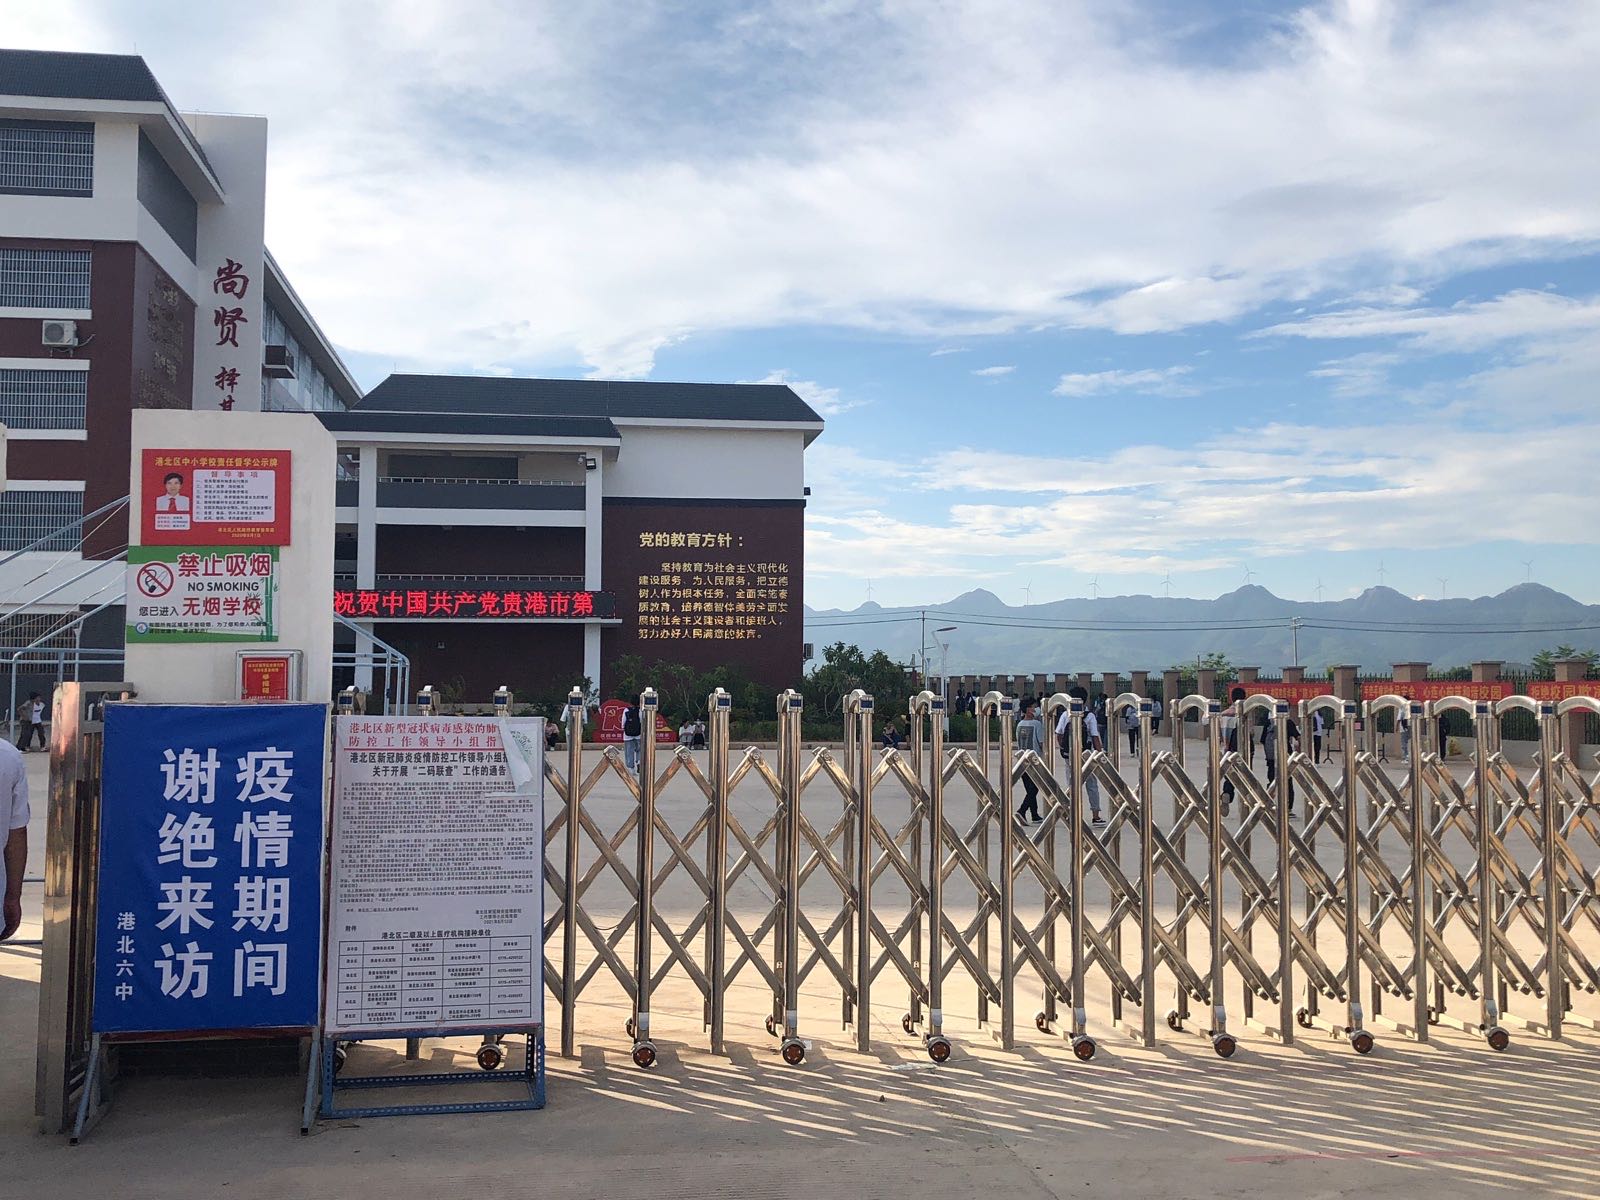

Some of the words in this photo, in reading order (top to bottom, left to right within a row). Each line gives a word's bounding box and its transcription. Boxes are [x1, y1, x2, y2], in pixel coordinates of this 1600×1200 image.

[213, 258, 249, 347] 尚贤
[640, 532, 744, 548] 党的教育方针：
[178, 554, 271, 577] 禁止吸烟
[188, 582, 204, 591] NO
[207, 582, 259, 591] SMOKING
[139, 606, 179, 617] 您已进入
[183, 597, 261, 617] 无烟学校
[334, 591, 593, 615] 祝贺中国共产党贵港市第
[154, 748, 220, 1000] 谢绝来访
[232, 747, 294, 996] 疫情期间
[115, 912, 136, 1001] 港北六中
